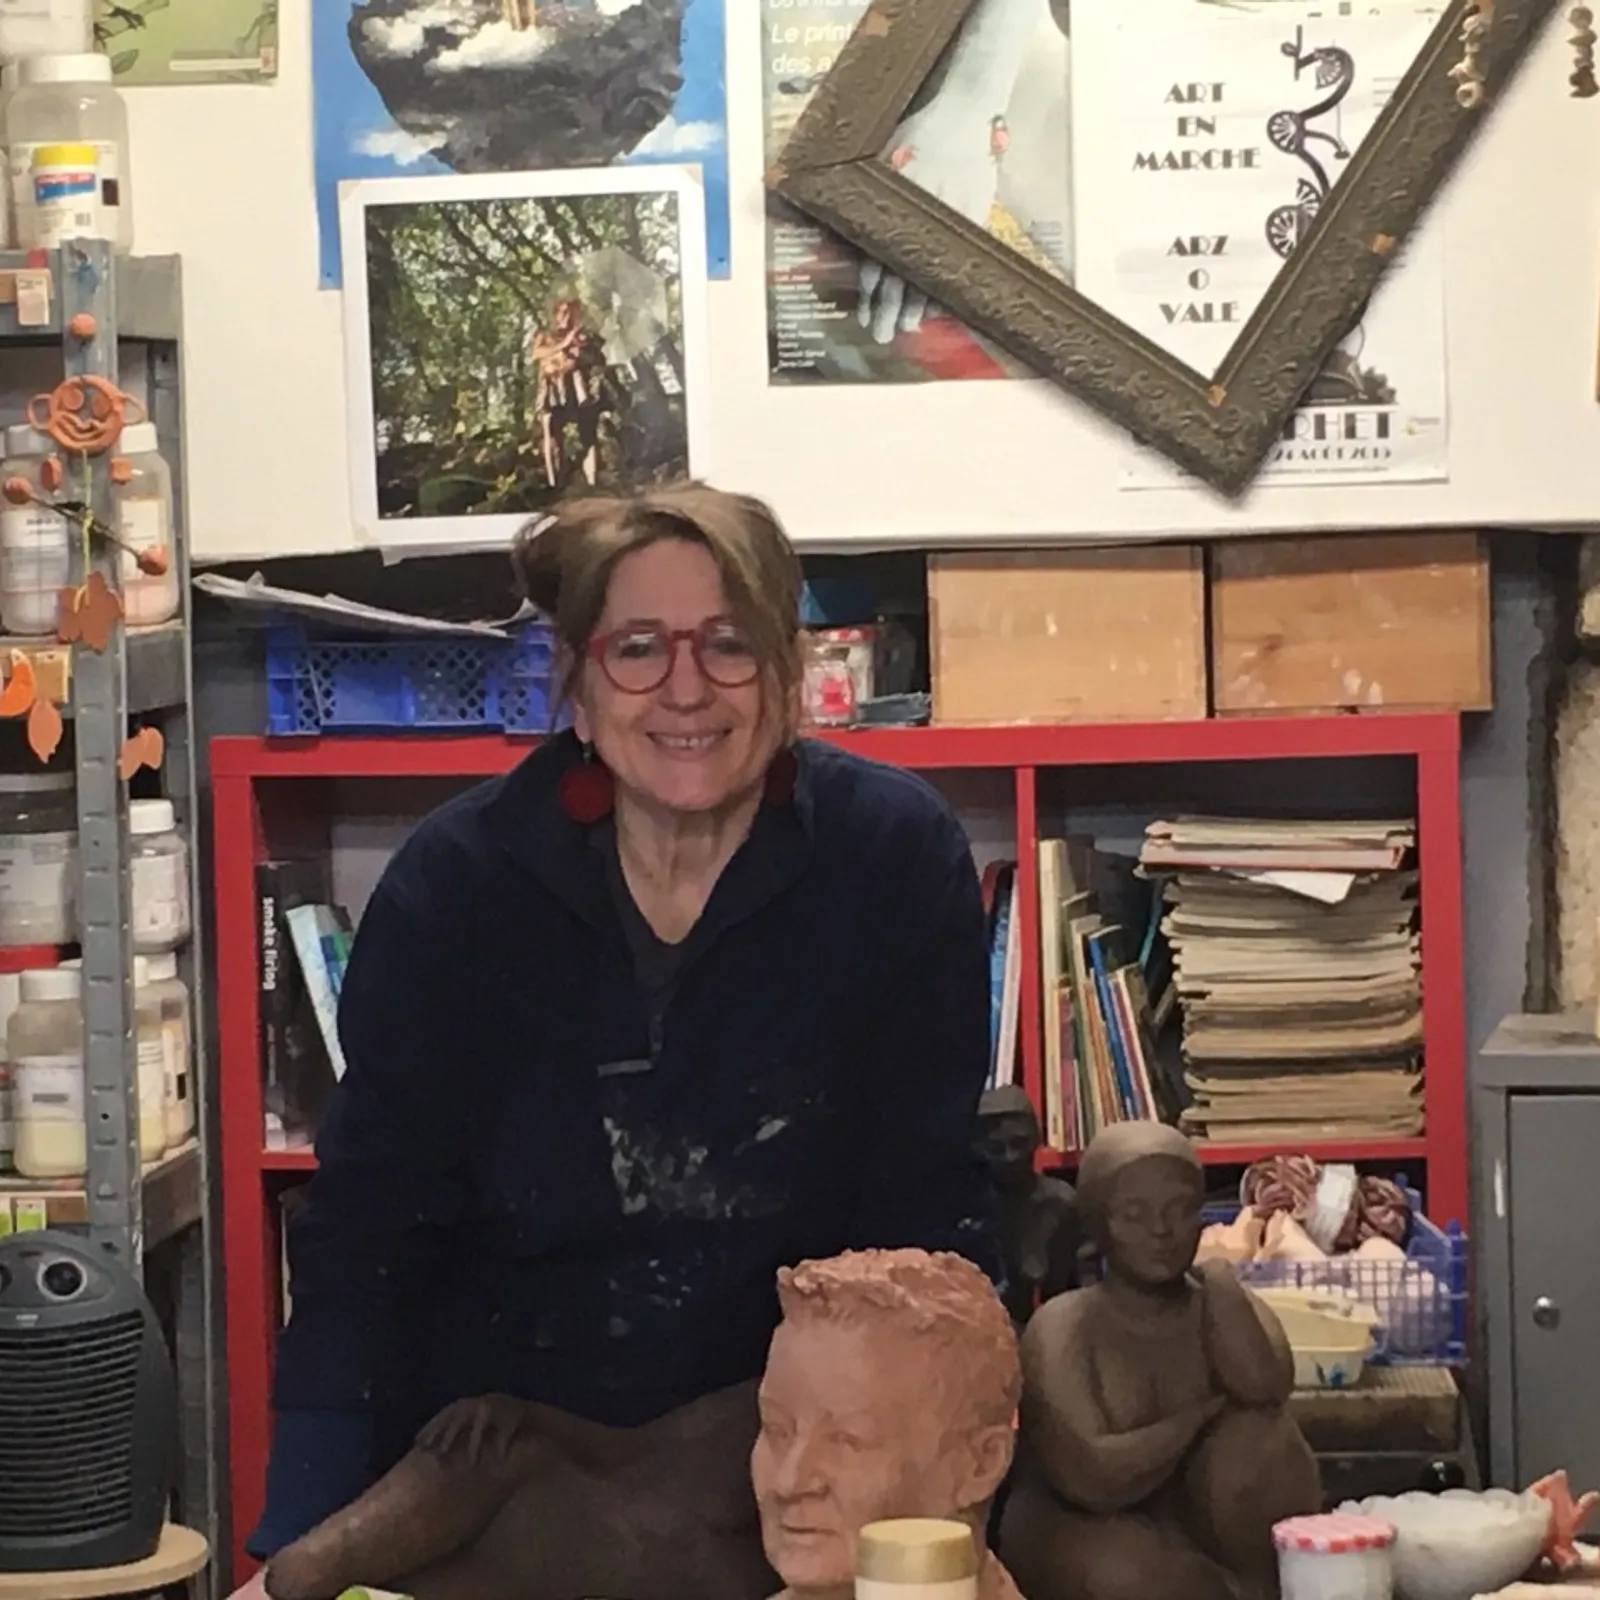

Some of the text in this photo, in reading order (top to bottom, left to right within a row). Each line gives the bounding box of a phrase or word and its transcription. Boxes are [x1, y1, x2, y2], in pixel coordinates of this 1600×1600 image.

[770, 23, 800, 44] Le
[771, 52, 833, 74] des a
[1163, 82, 1226, 104] ART
[1177, 115, 1216, 137] EN
[1132, 147, 1262, 171] MARCHE
[1165, 235, 1229, 257] ARZ
[1187, 267, 1211, 291] O
[1158, 301, 1241, 325] VALE
[1282, 411, 1397, 441] RHET
